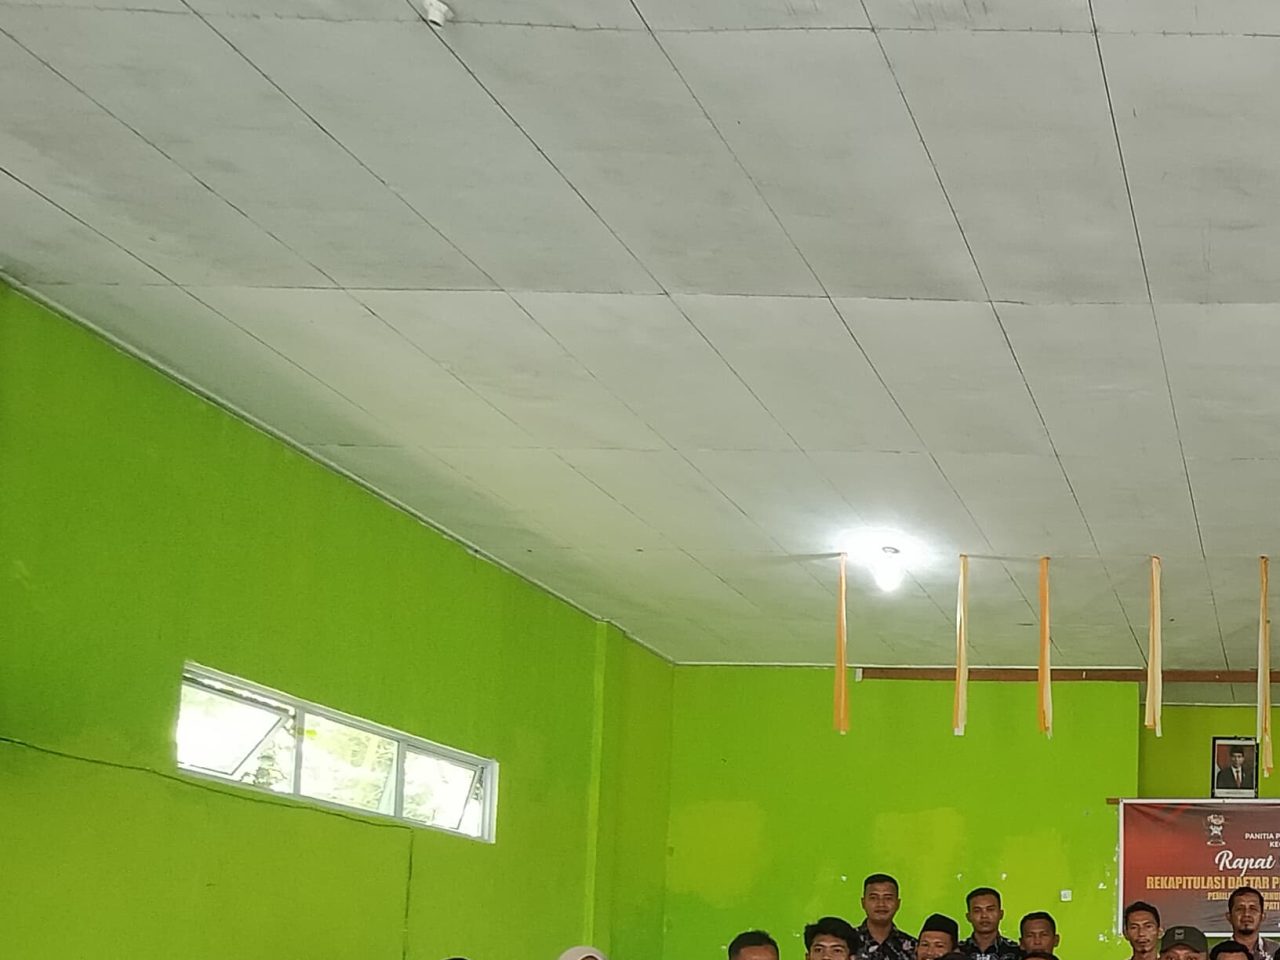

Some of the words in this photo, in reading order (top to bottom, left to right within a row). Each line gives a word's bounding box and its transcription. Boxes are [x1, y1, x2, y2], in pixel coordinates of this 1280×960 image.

[1215, 850, 1276, 877] Rapat
[1146, 876, 1225, 889] REKAPITULASI
[1227, 876, 1270, 889] DAFTAR
